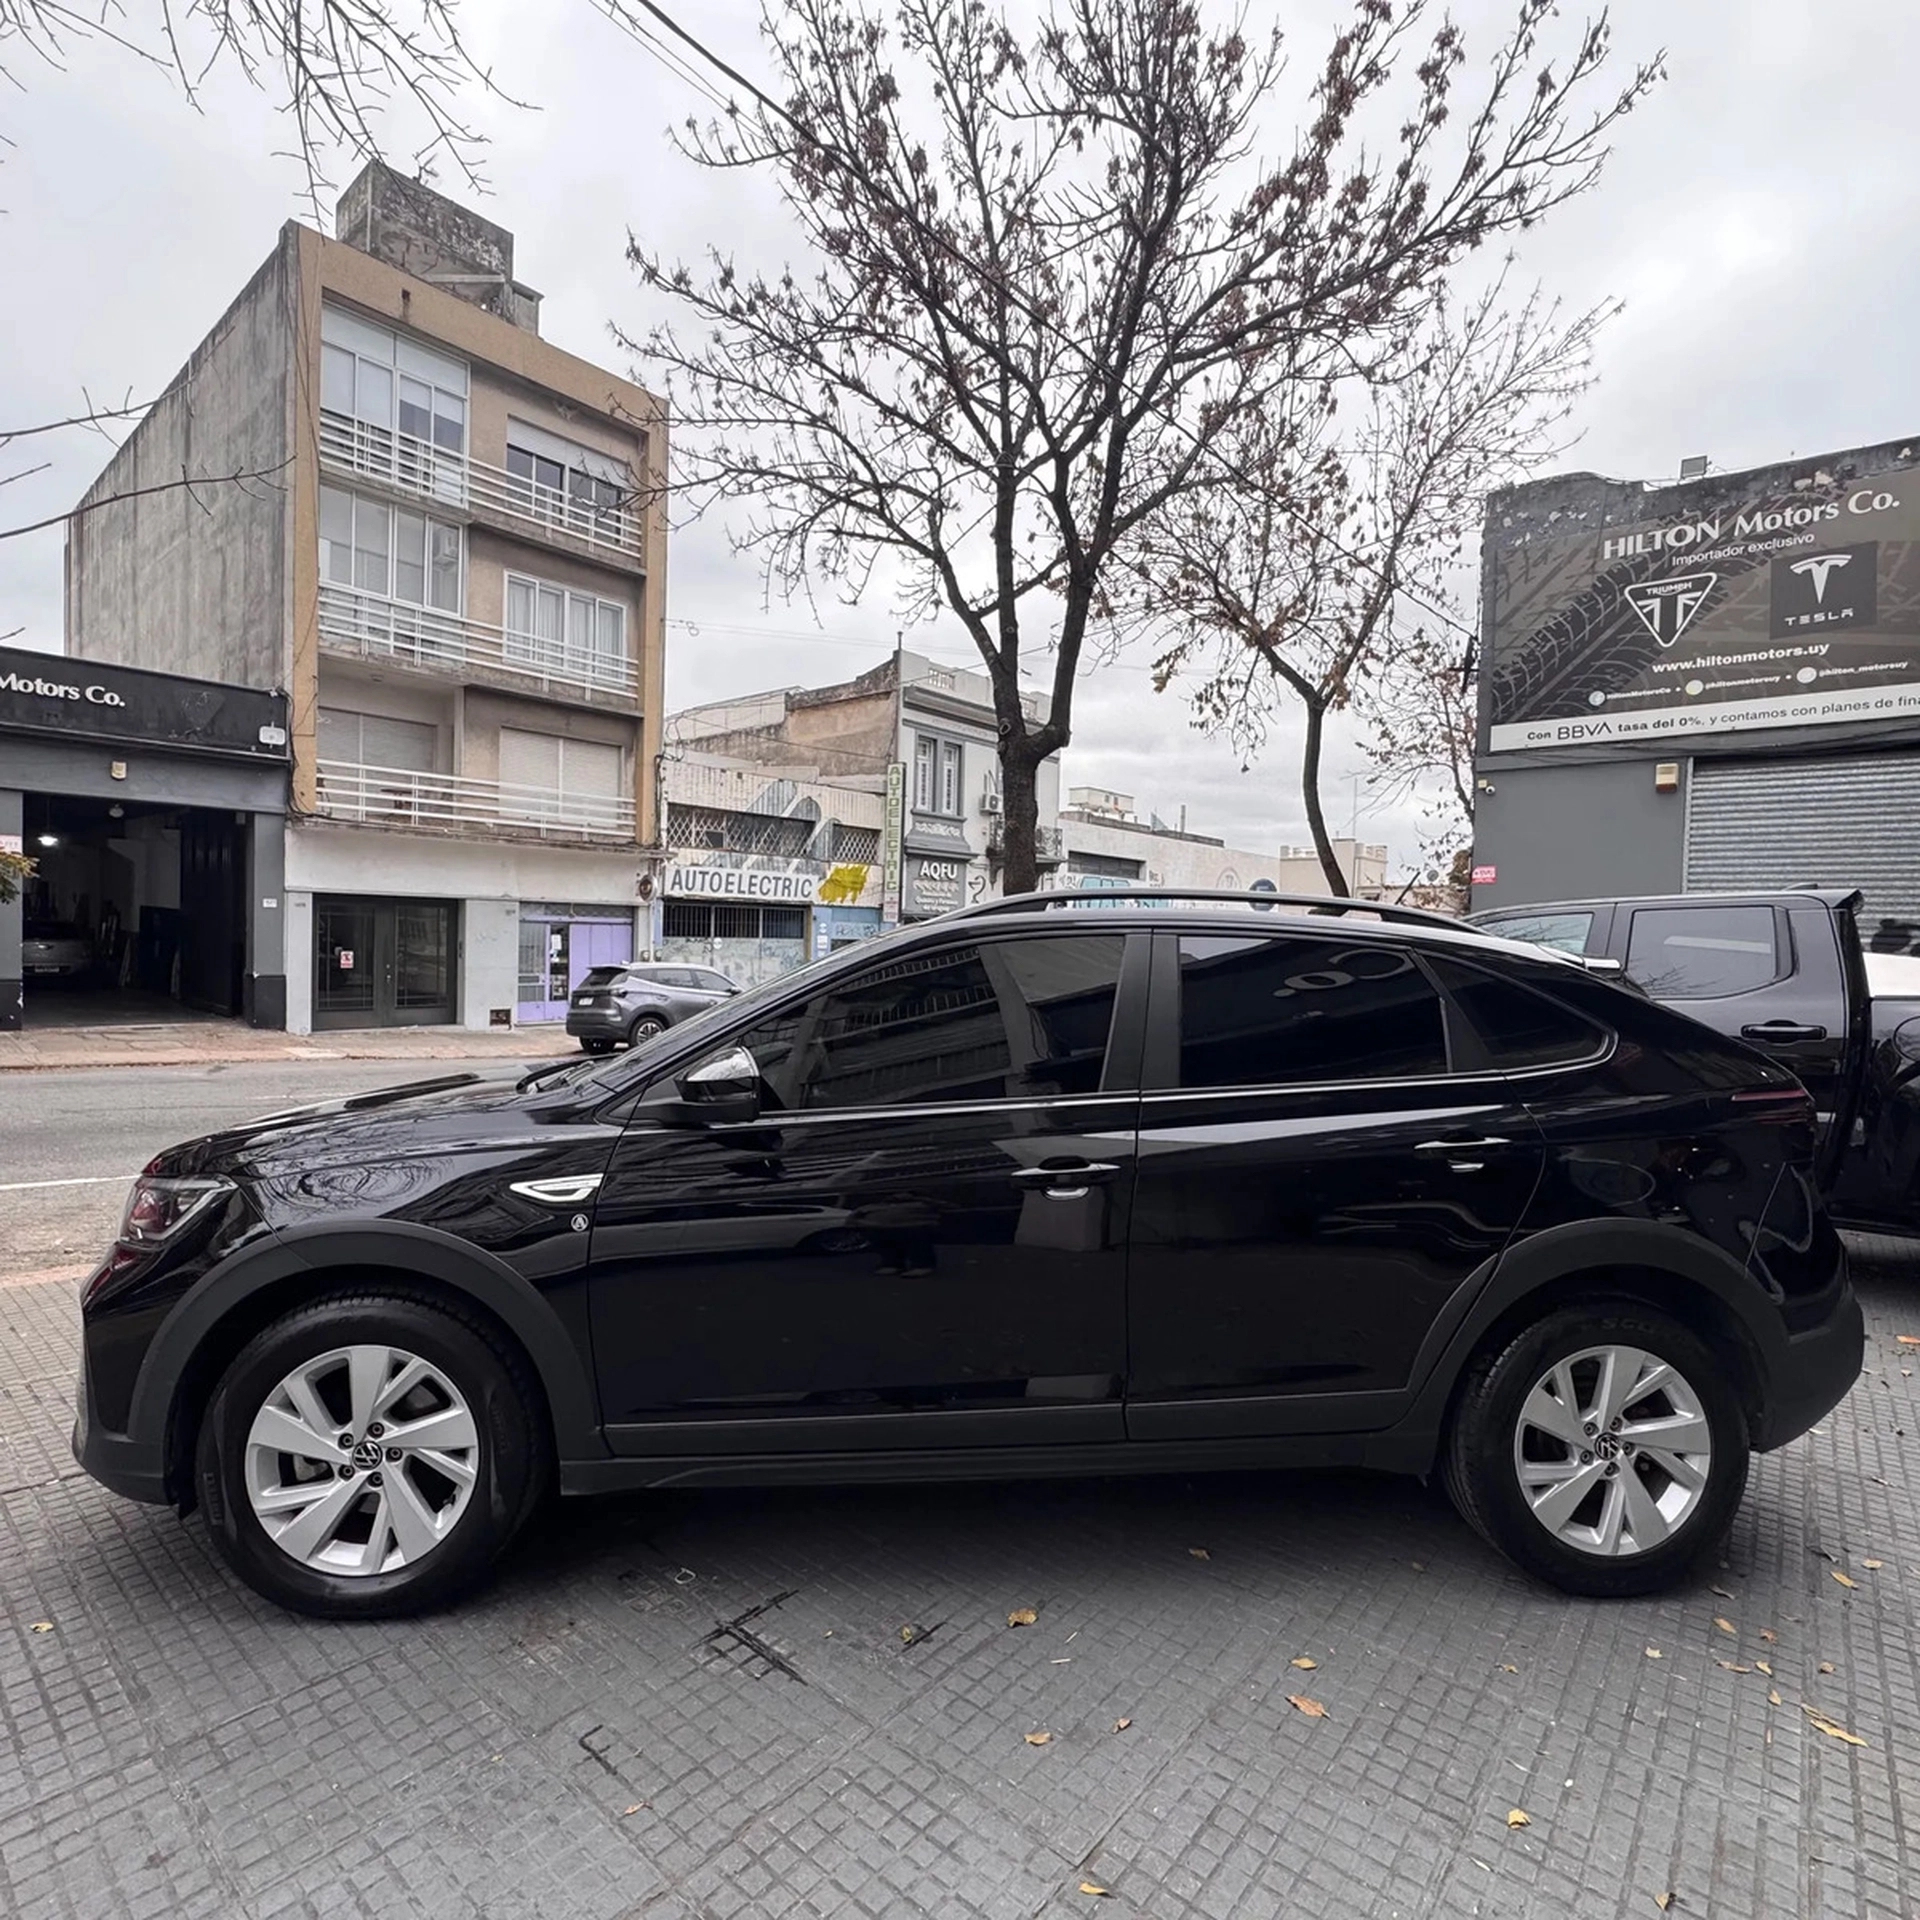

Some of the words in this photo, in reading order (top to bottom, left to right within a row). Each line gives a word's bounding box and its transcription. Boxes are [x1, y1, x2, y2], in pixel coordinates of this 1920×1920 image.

[1604, 519, 1719, 559] HILTON
[1734, 502, 1839, 536] Motors
[1848, 490, 1900, 514] Co.
[1672, 545, 1744, 566] Importador
[1748, 533, 1815, 553] exclusivo
[1646, 582, 1692, 596] TRIUMPH
[1785, 608, 1853, 626] TESLA
[1652, 643, 1830, 673] www.hiltonmotors.uy
[85, 685, 125, 707] Co.
[1527, 731, 1551, 740] Con
[1557, 722, 1612, 740] BBVA
[1618, 723, 1648, 732] tasa
[1652, 718, 1674, 730] del
[1709, 715, 1718, 725] y
[1720, 709, 1787, 723] contamos
[1791, 705, 1817, 716] con
[1821, 701, 1870, 715] planes
[1874, 698, 1893, 709] de
[670, 869, 813, 898] AUTOELECTRIC
[920, 861, 957, 880] AQFU
